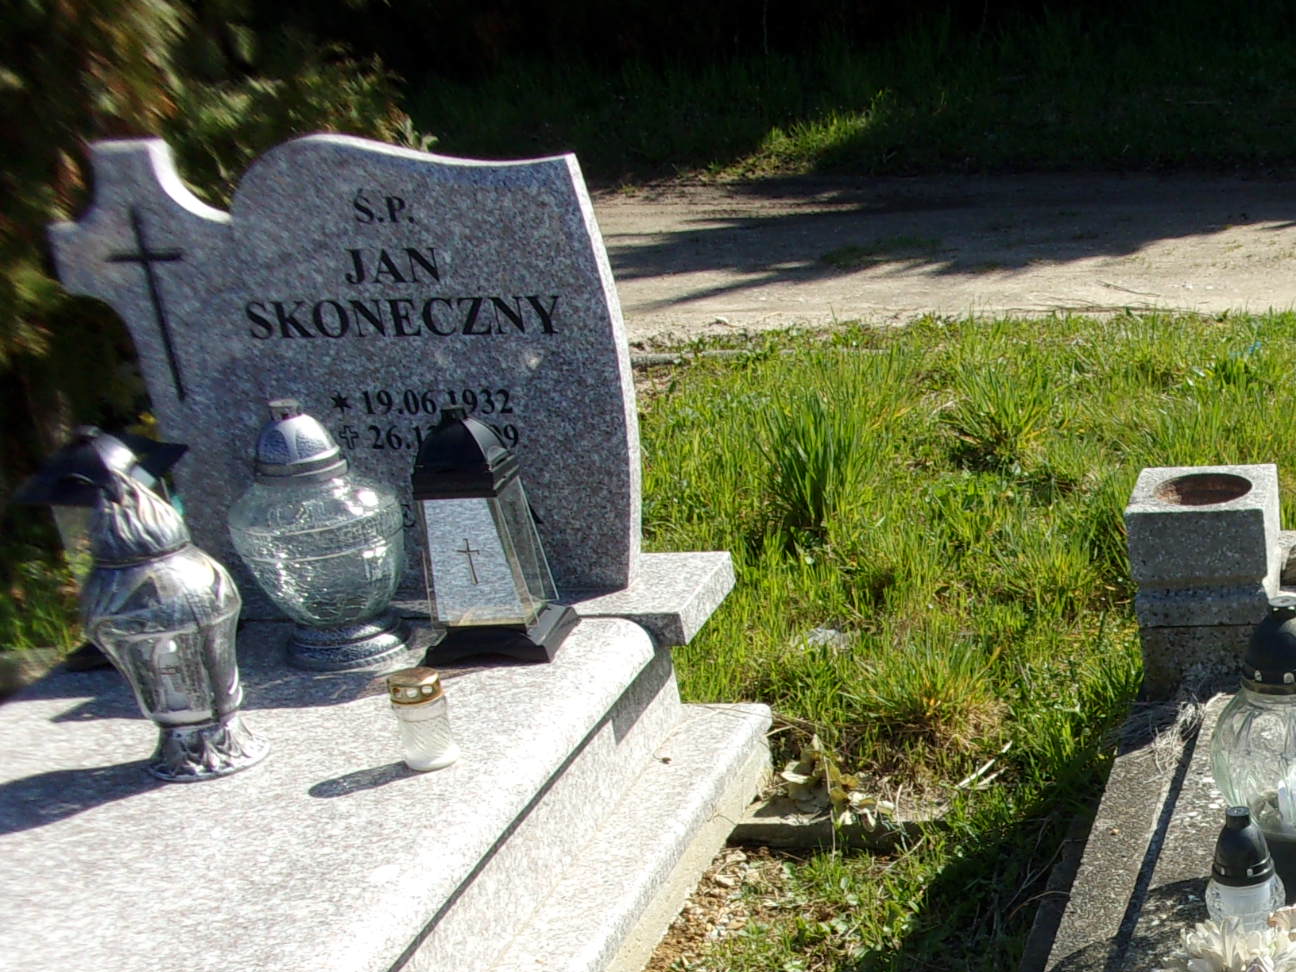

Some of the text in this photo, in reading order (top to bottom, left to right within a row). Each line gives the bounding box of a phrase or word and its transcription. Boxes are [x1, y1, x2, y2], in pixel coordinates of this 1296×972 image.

[345, 248, 441, 285] JAN
[245, 294, 560, 340] SKONECZNY
[361, 388, 514, 416] 19.061932
